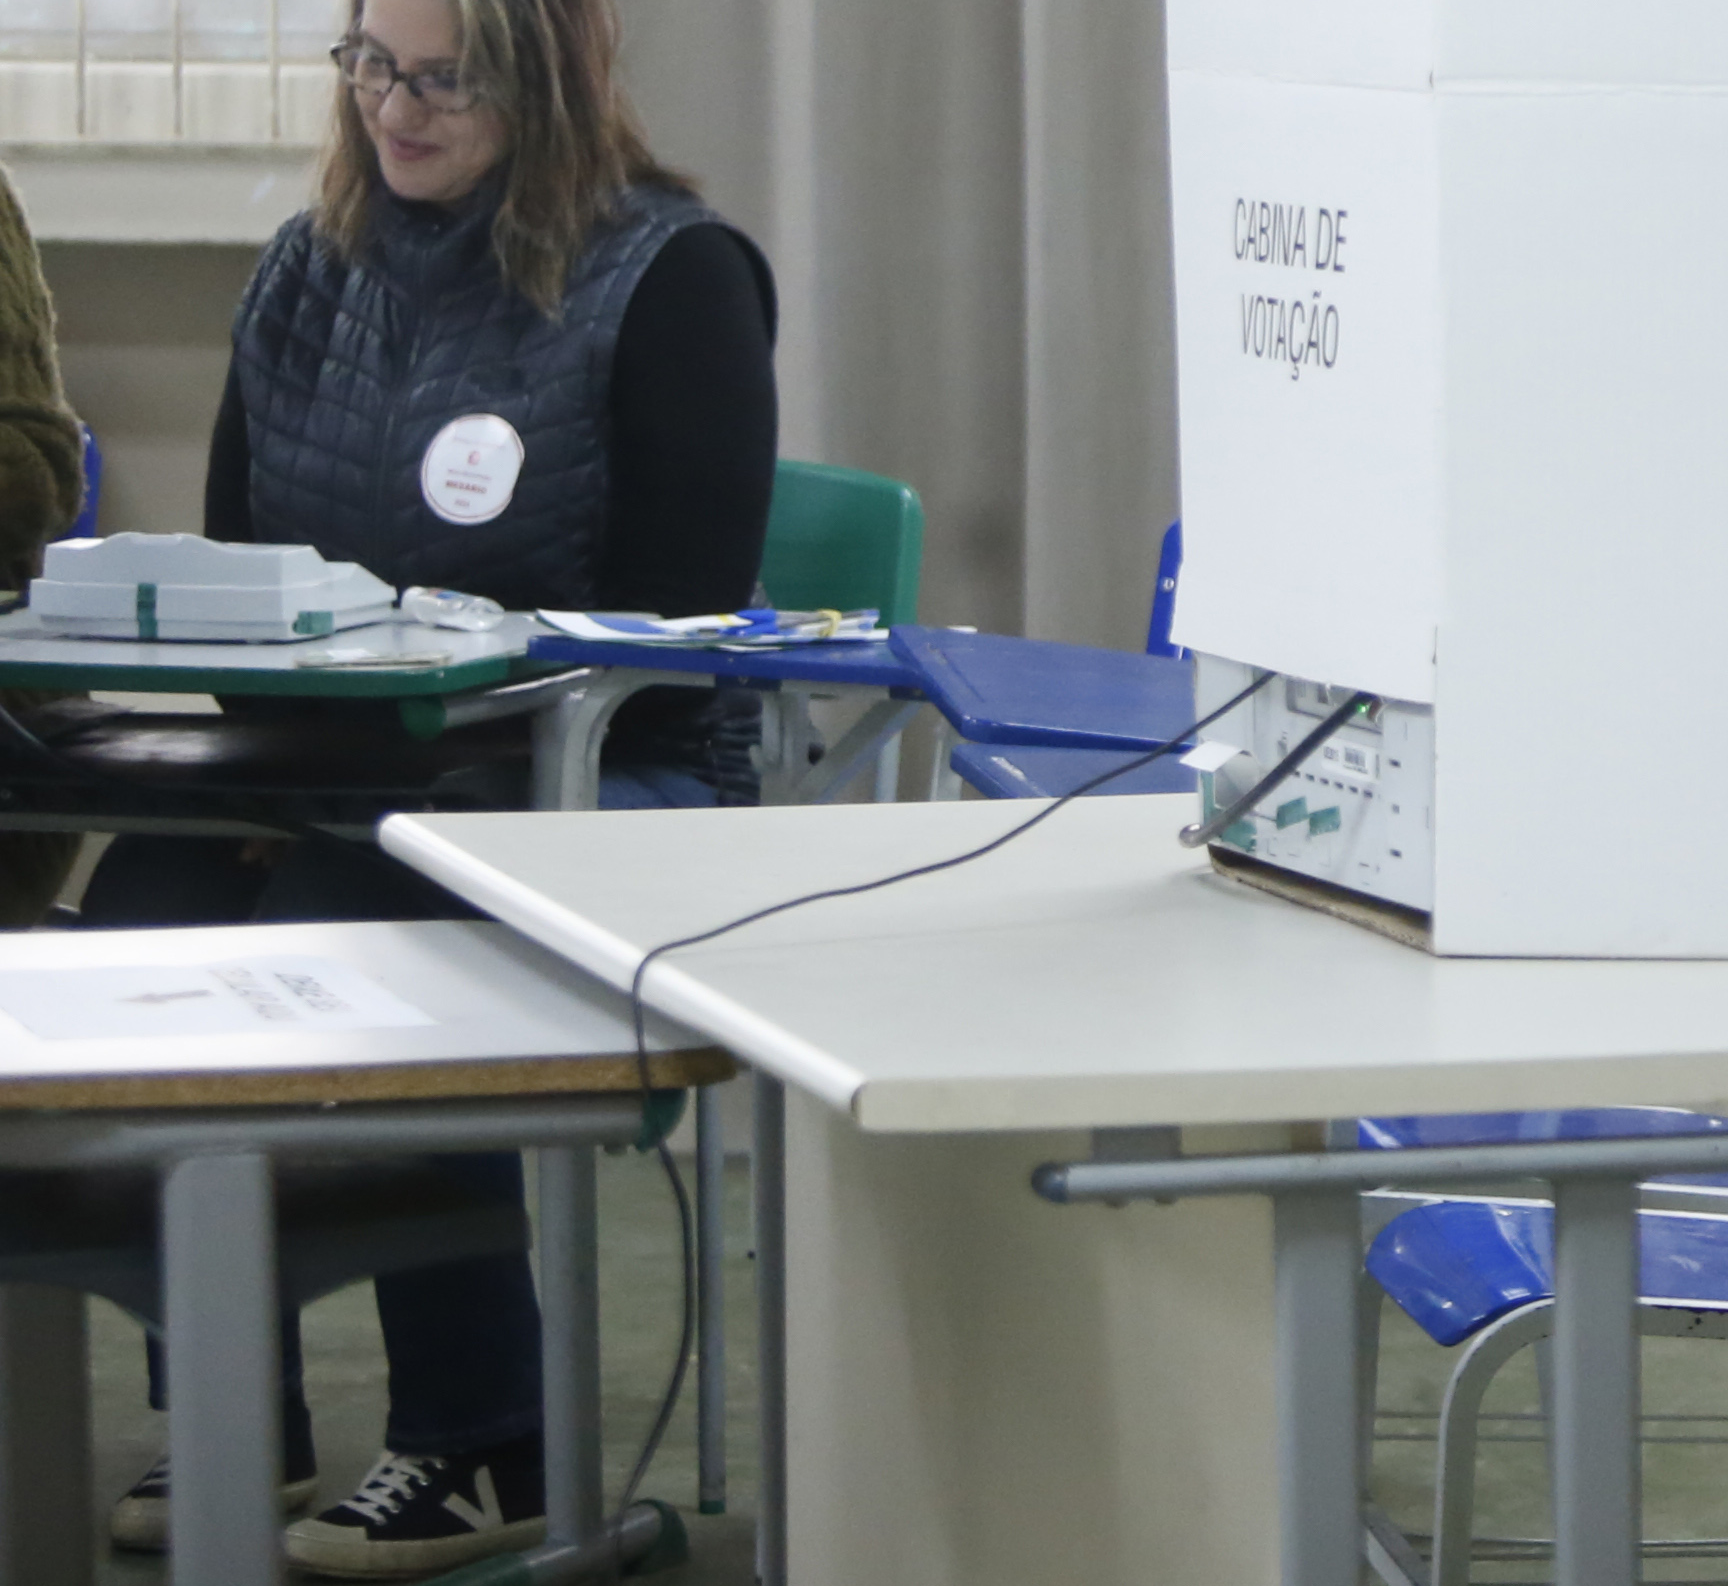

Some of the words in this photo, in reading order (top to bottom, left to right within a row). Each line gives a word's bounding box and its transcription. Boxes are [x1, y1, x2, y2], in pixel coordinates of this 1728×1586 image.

[1234, 198, 1307, 268] CABINA
[1315, 208, 1348, 273] DE
[1241, 290, 1340, 381] VOTAÇÃO
